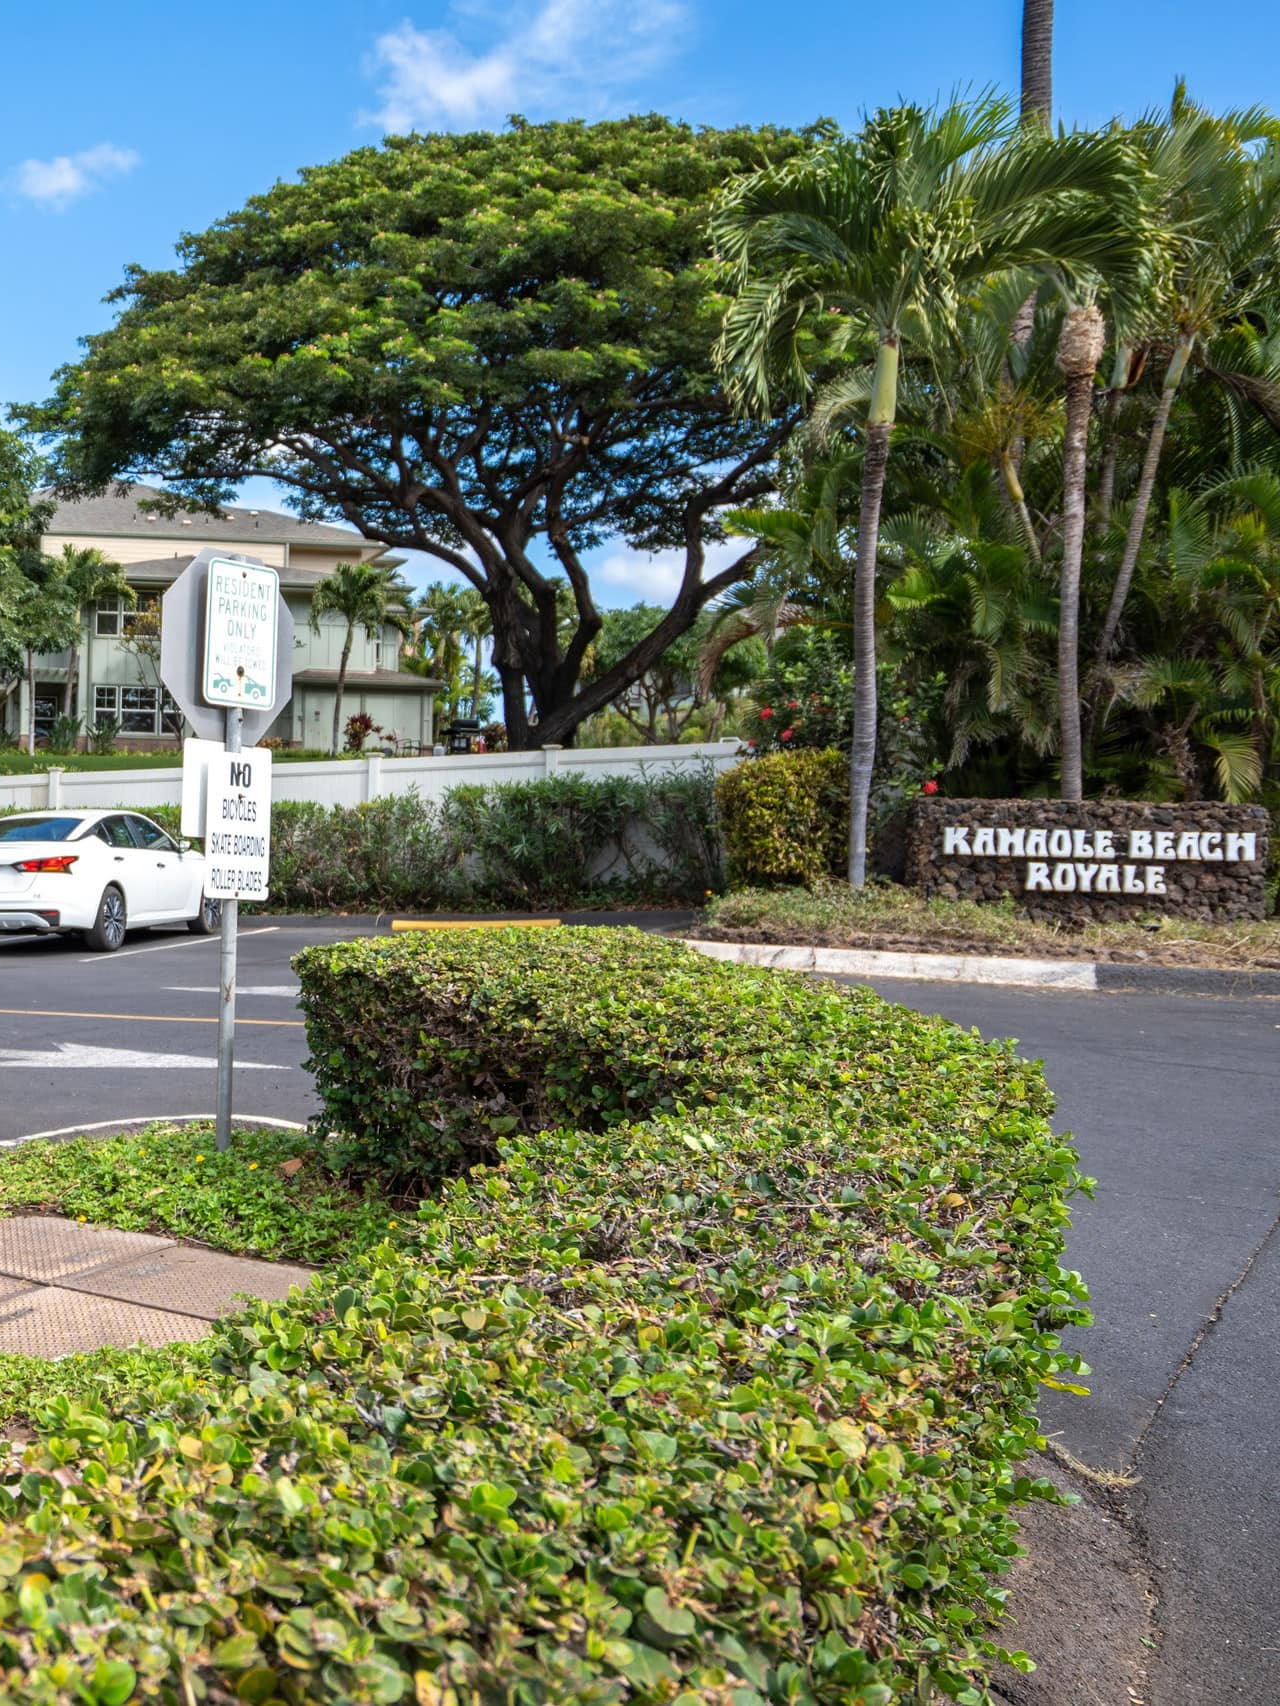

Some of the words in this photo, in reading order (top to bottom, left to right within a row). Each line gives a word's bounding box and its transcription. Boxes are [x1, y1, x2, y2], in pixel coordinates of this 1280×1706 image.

[216, 575, 271, 601] RESIDENT
[218, 596, 267, 622] PARKING
[227, 619, 257, 640] ONLY
[230, 761, 252, 788] NO
[222, 798, 257, 822] BICYCLES
[211, 832, 232, 855] SKATE
[233, 834, 265, 858] BOARDING
[943, 826, 1116, 858] KAMAOLE
[1129, 829, 1257, 862] BEACH
[211, 868, 236, 890] ROLLER
[237, 869, 262, 892] BLADES
[1025, 861, 1168, 895] ROYALE
